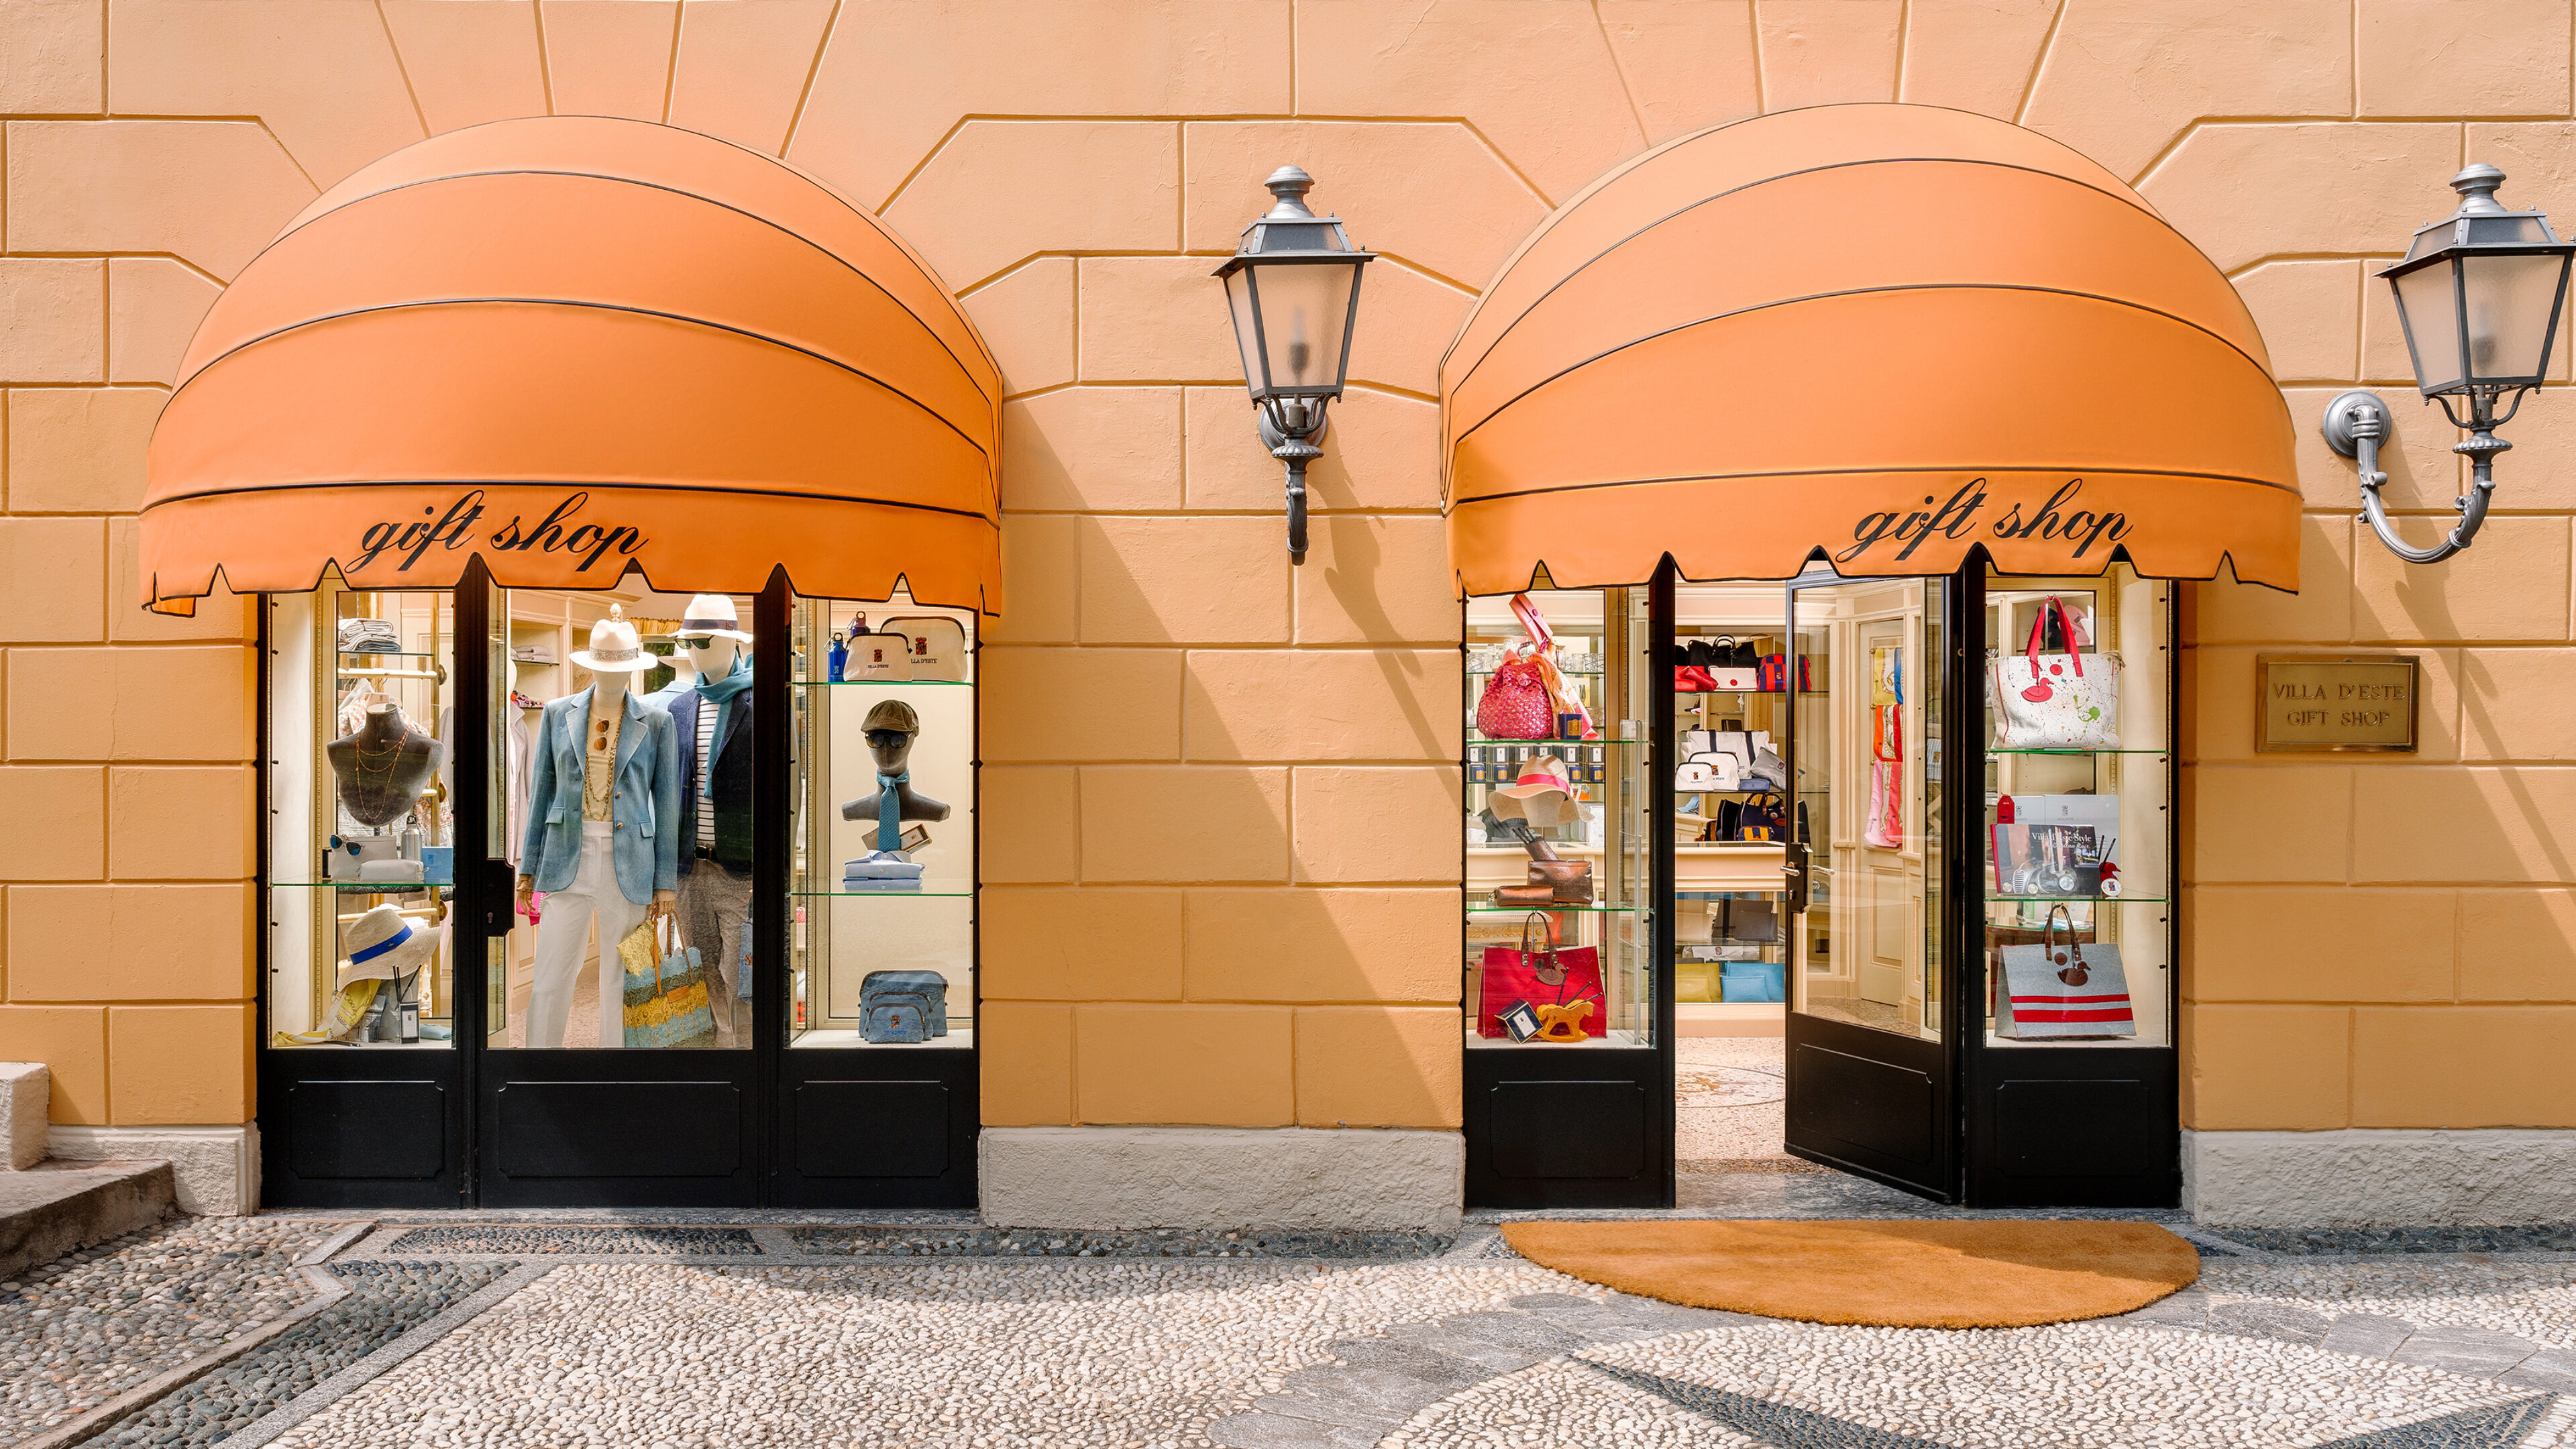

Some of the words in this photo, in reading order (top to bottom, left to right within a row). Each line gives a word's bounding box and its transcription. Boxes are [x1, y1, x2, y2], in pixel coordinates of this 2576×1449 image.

[1837, 477, 1988, 564] gift
[1992, 478, 2134, 559] shop
[344, 489, 486, 574] gift
[490, 491, 649, 572] shop
[2273, 683, 2328, 700] VILLA
[2339, 683, 2406, 700] D'ESTE
[2287, 710, 2330, 726] GIFT
[2341, 710, 2390, 726] SHOP
[2074, 833, 2092, 845] Style
